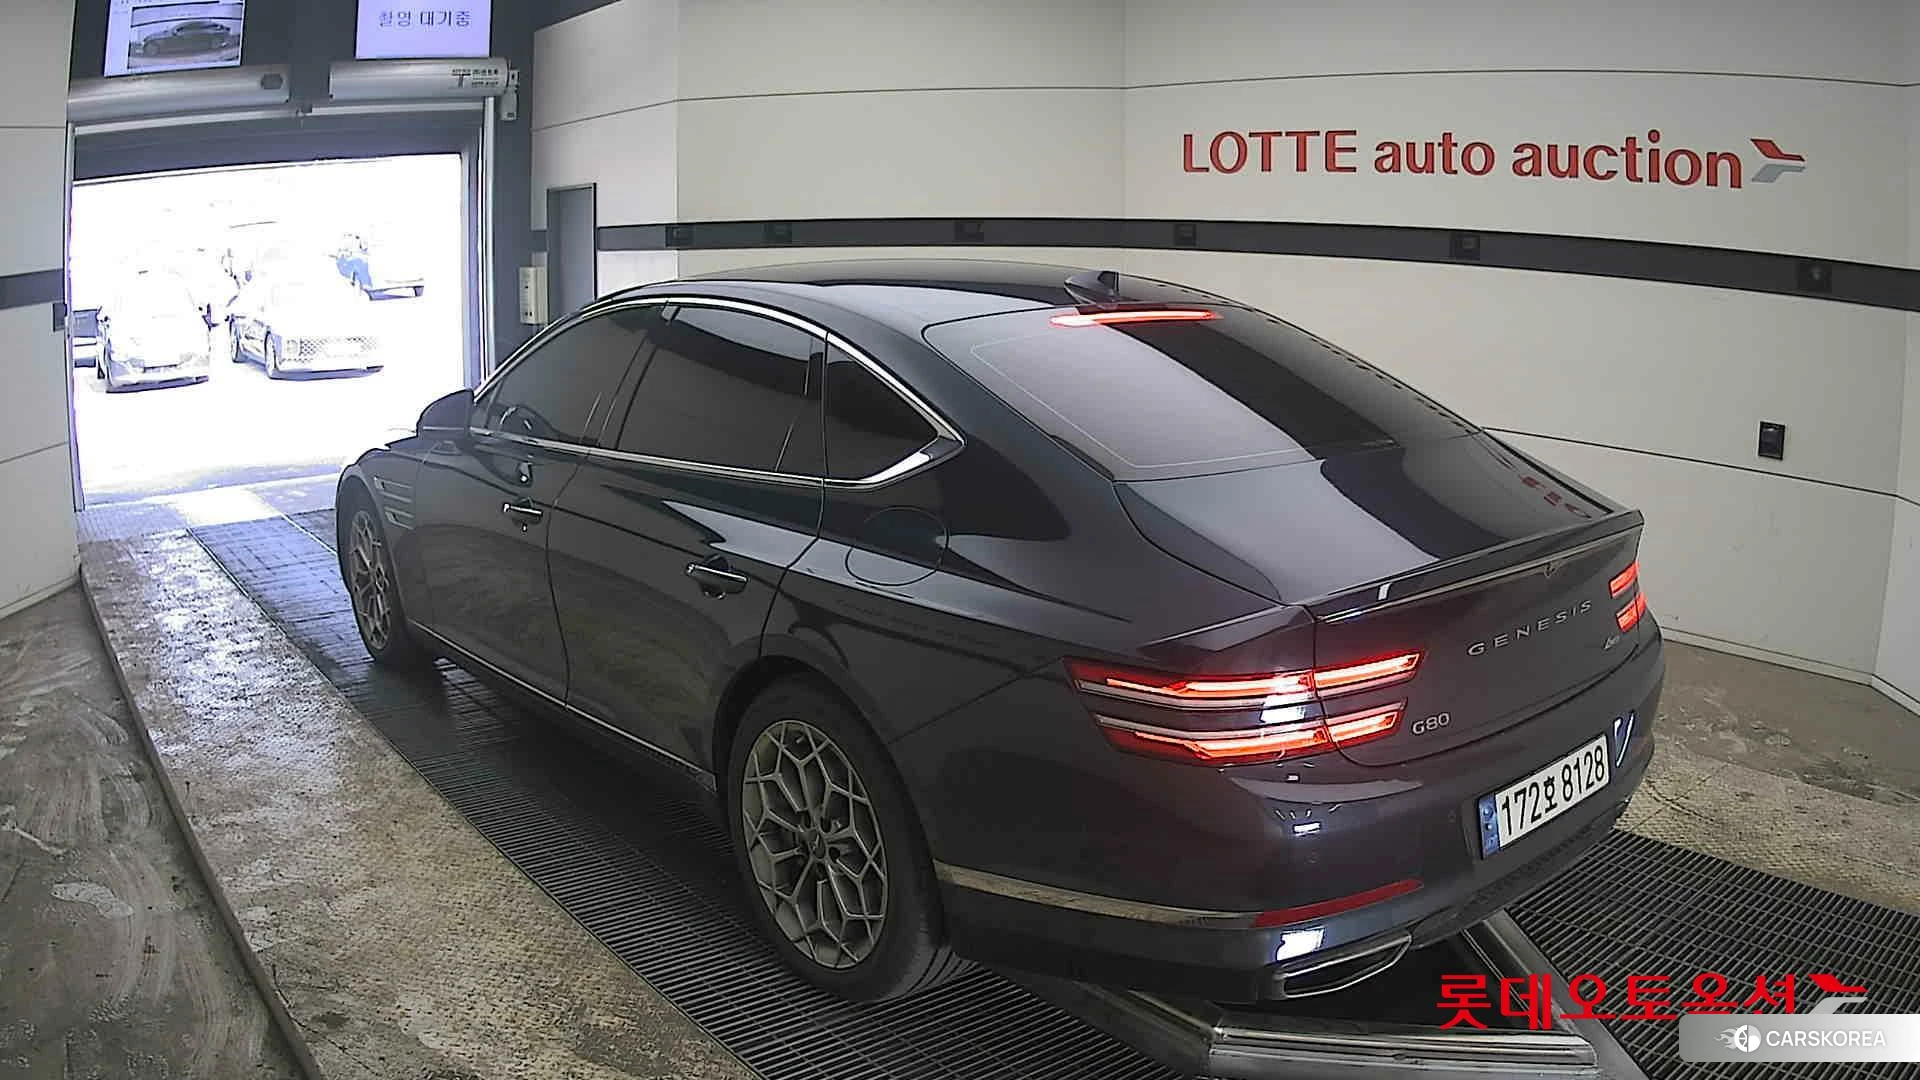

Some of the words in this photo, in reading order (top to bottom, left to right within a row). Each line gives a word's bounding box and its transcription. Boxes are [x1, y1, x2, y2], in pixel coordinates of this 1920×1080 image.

[419, 10, 471, 28] 대기중
[1183, 129, 1359, 174] LOTTE
[1374, 131, 1496, 176] auto
[1511, 129, 1743, 189] auction
[1466, 600, 1594, 657] GENESIS
[1411, 712, 1451, 736] G80
[1561, 745, 1606, 803] 8128
